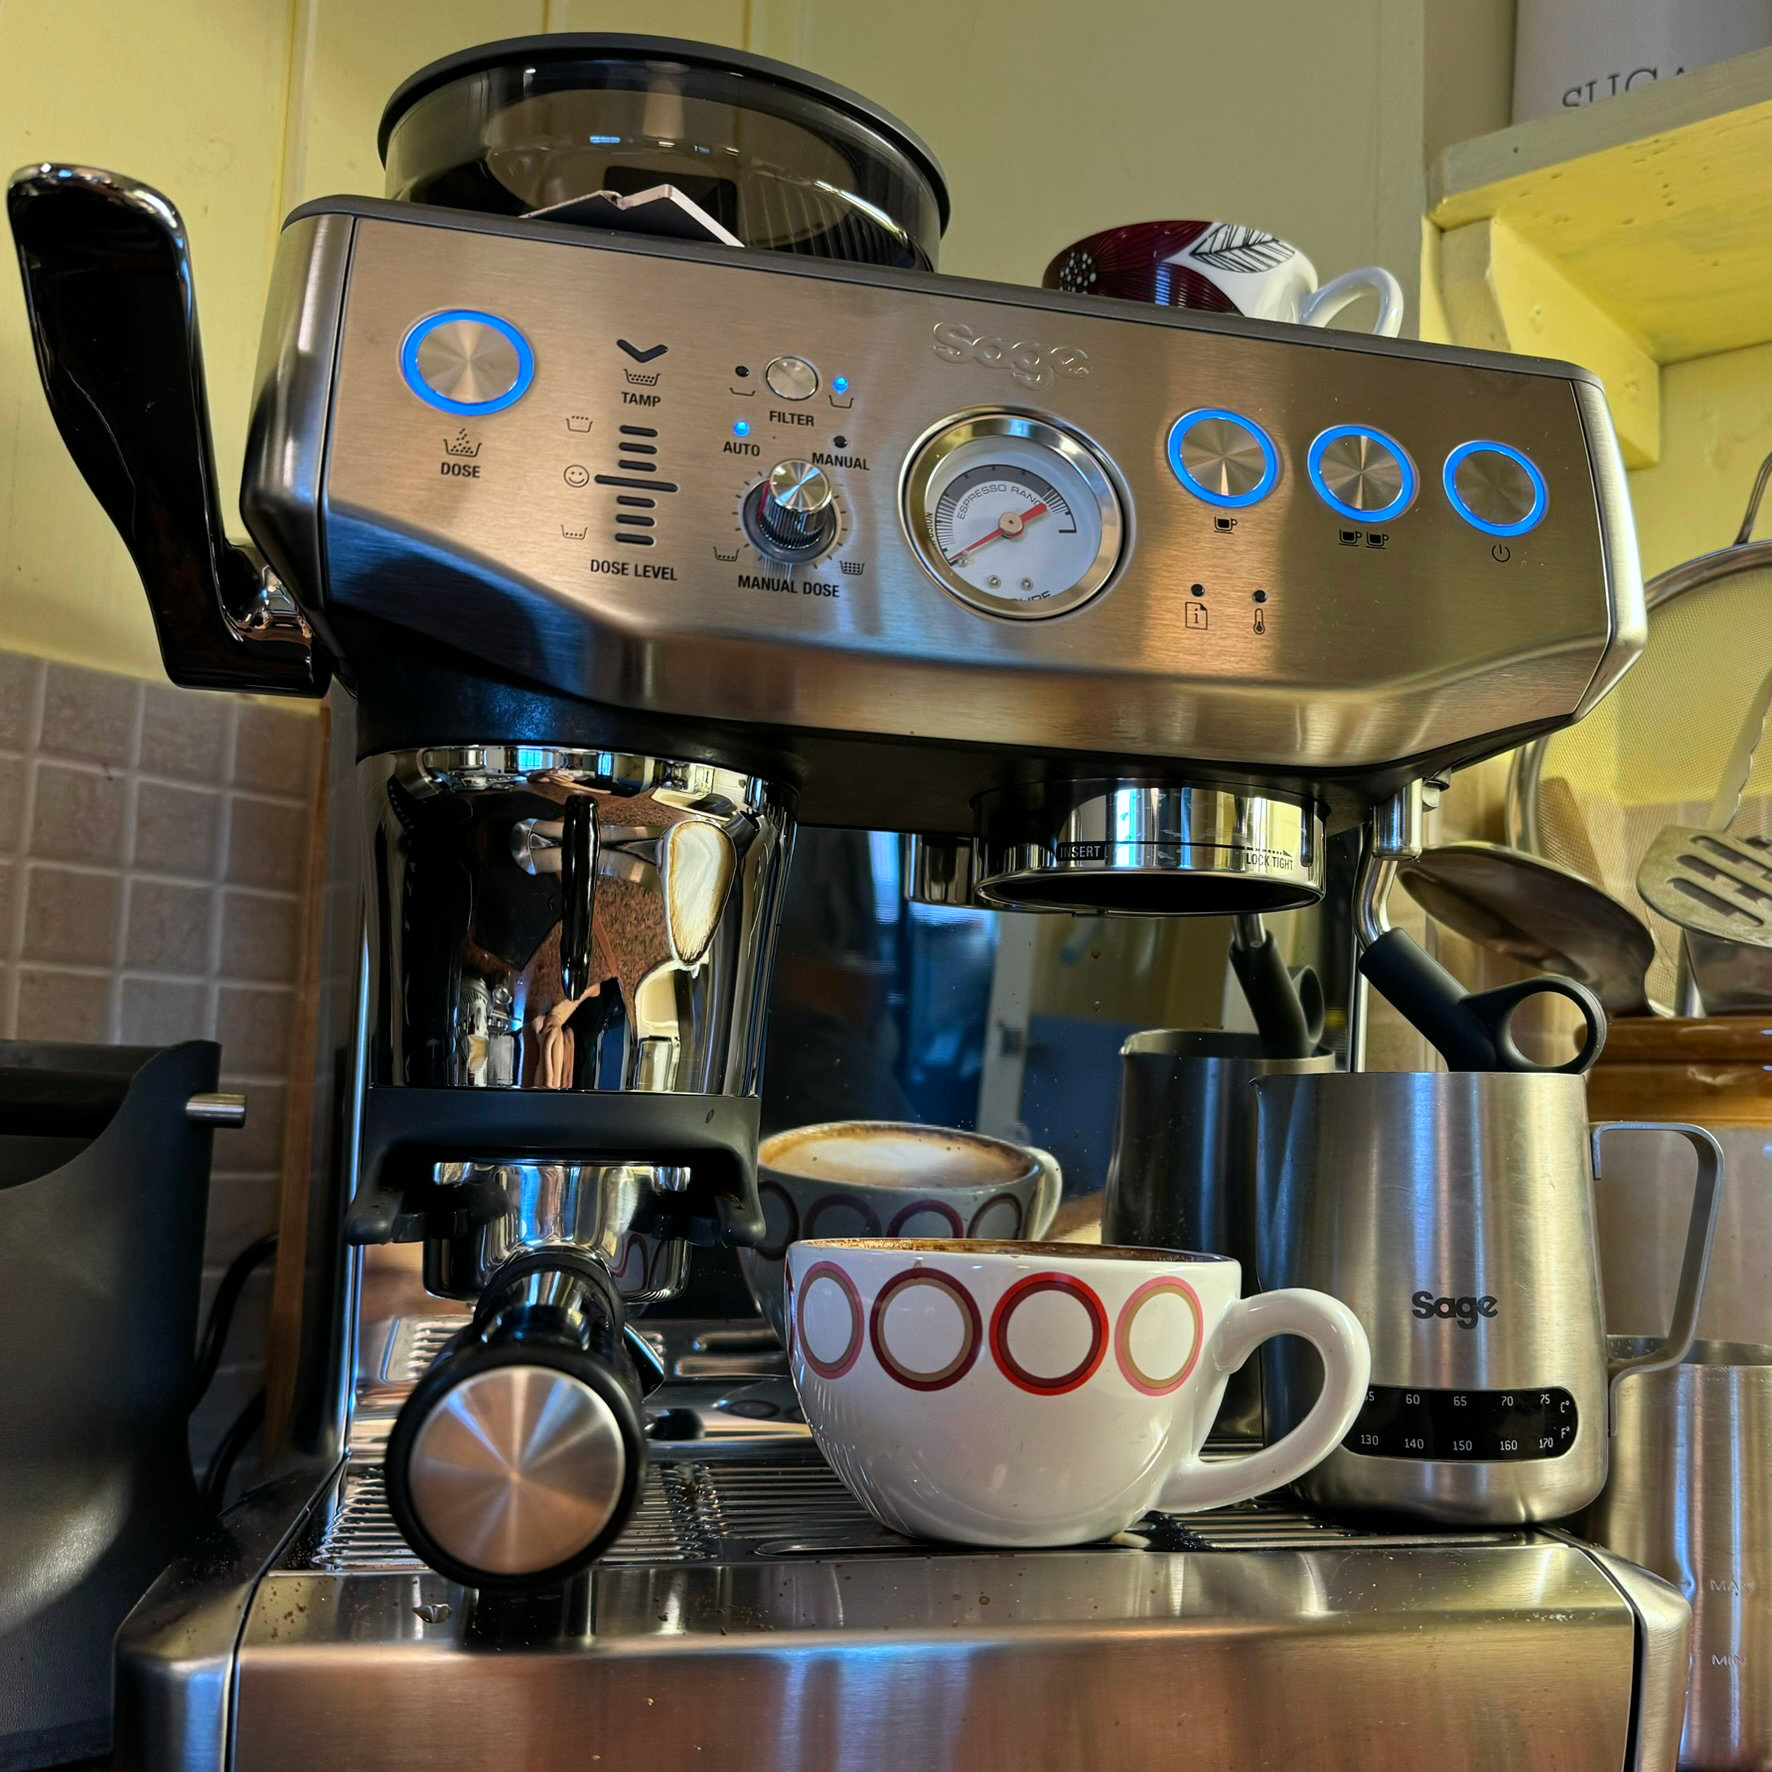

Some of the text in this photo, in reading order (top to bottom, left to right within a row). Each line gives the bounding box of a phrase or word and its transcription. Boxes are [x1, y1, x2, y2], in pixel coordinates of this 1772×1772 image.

[932, 321, 1090, 391] Sage
[620, 391, 661, 407] TAMP
[769, 410, 815, 427] FILTER
[723, 441, 761, 457] AUTO
[812, 452, 870, 471] MANUAL
[440, 462, 481, 479] DOSE
[956, 483, 1007, 520] ESPRESSO
[590, 559, 678, 581] DOSE LEVEL
[737, 574, 841, 598] MANUAL DOSE
[1060, 845, 1102, 859] INSERT
[1246, 852, 1294, 871] LOCK TIGHT
[1411, 1290, 1499, 1330] Sage
[1405, 1393, 1421, 1405] 60
[1453, 1395, 1468, 1407] 65
[1501, 1395, 1514, 1407] 70
[1540, 1393, 1551, 1405] 75
[1360, 1434, 1379, 1446] 130
[1404, 1438, 1425, 1450] 140
[1452, 1440, 1473, 1451] 150
[1500, 1440, 1518, 1451] 160
[1539, 1437, 1554, 1449] 170
[1711, 1654, 1747, 1666] MIN
